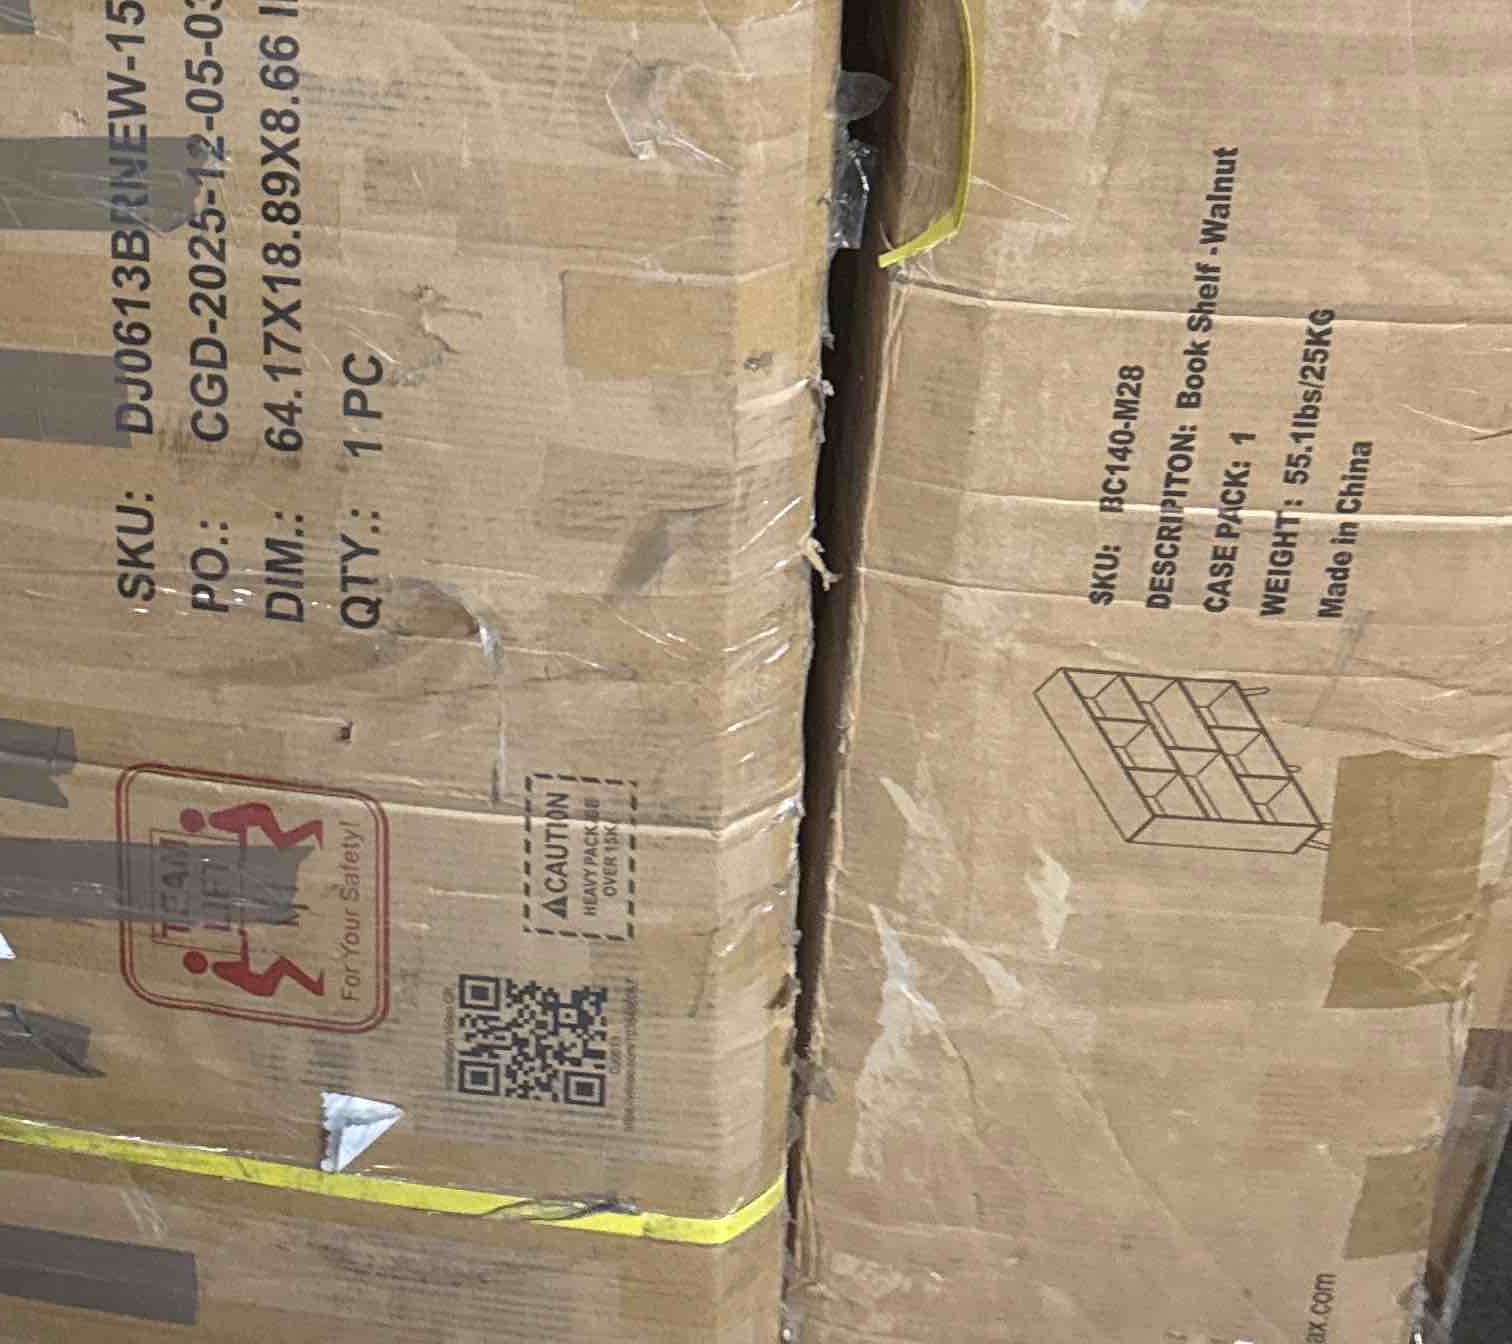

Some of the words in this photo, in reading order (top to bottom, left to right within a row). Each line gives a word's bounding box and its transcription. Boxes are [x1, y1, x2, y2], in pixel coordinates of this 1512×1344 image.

[258, 33, 304, 453] 64.17X18.89X8.66
[1186, 261, 1222, 334] Shelf
[342, 351, 384, 420] PC
[1175, 339, 1211, 410] Book
[1281, 308, 1337, 487] 55.1lbs/25KG
[343, 438, 384, 459] 1
[1099, 363, 1146, 514] BC140-M28
[1228, 431, 1258, 446] 1
[1214, 460, 1253, 541] PACK:
[1334, 441, 1374, 515] China
[116, 490, 156, 602] SKU:
[1144, 424, 1199, 611] DESCRIPITON:
[1329, 520, 1362, 547] in
[189, 519, 230, 613] PO.:
[264, 511, 304, 624] DIM.:
[340, 508, 383, 631] QTY.:
[1088, 544, 1123, 607] SKU:
[1202, 544, 1239, 614] CASE
[1316, 550, 1355, 620] Made
[338, 820, 365, 903] Safety!
[543, 792, 570, 894] CAUTION
[602, 856, 618, 897] OVER
[583, 868, 600, 917] HEAVY
[339, 910, 362, 964] Your
[340, 965, 362, 1002] For
